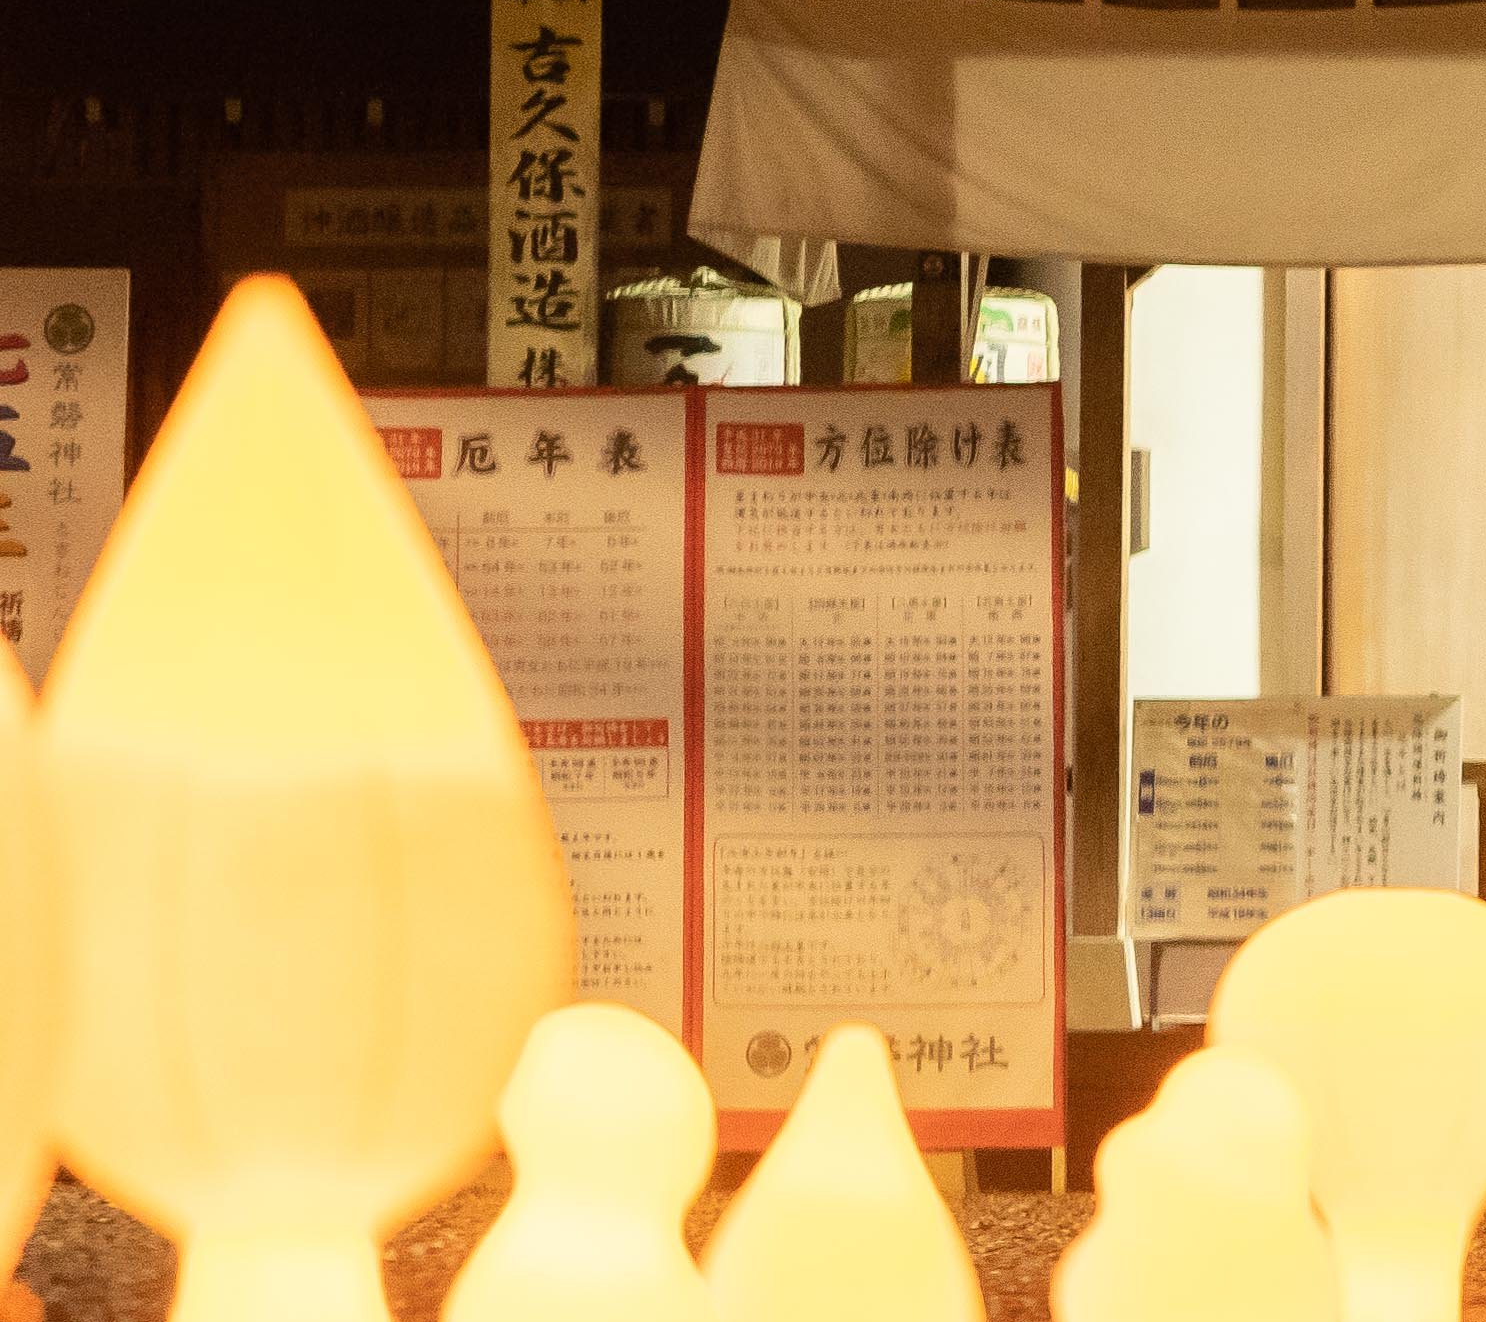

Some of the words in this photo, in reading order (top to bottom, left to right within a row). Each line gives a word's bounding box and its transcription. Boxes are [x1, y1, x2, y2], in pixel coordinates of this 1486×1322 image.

[454, 429, 650, 478] 厄年表
[814, 420, 1028, 473] 方位除け表
